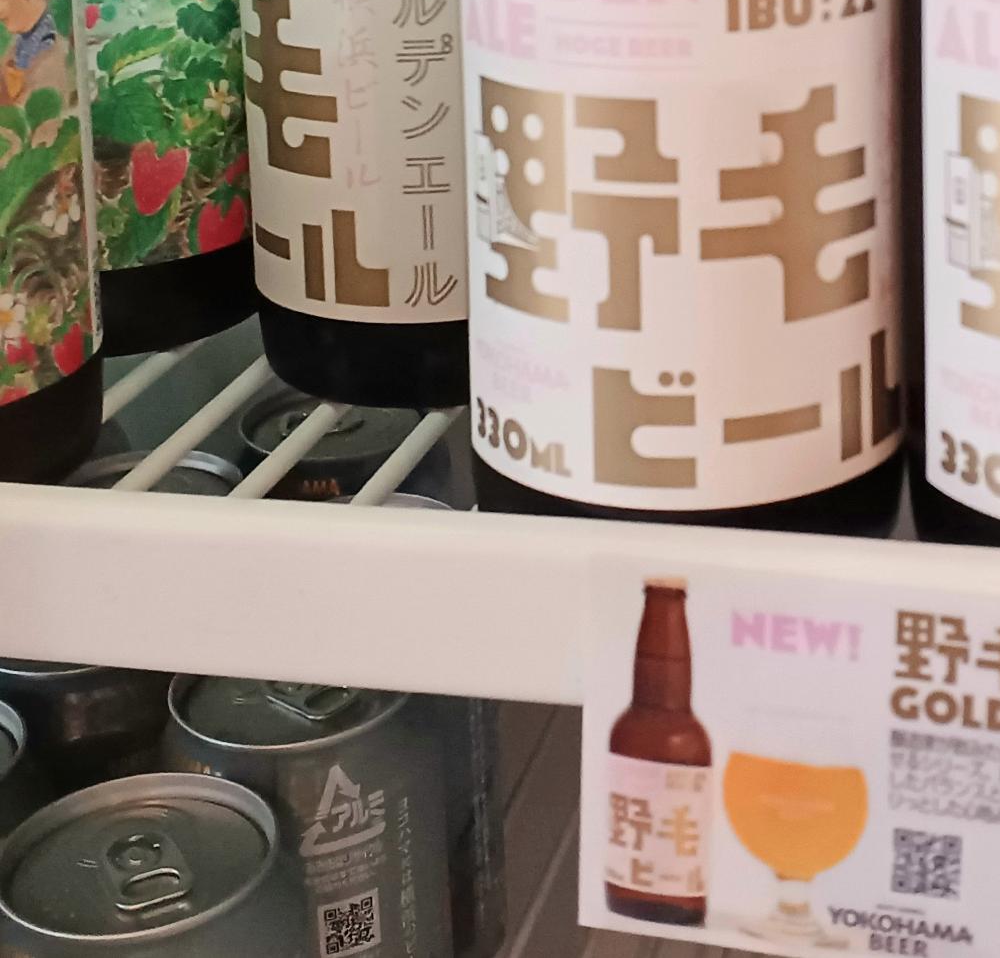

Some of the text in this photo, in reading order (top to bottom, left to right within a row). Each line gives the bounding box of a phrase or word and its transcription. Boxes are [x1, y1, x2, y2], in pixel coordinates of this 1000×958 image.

[479, 75, 876, 332] 野毛
[592, 328, 900, 489] ビール
[730, 609, 863, 661] NEW!
[331, 790, 386, 833] アルミ
[827, 903, 974, 946] YOKOHAMA
[868, 933, 930, 958] BEER
